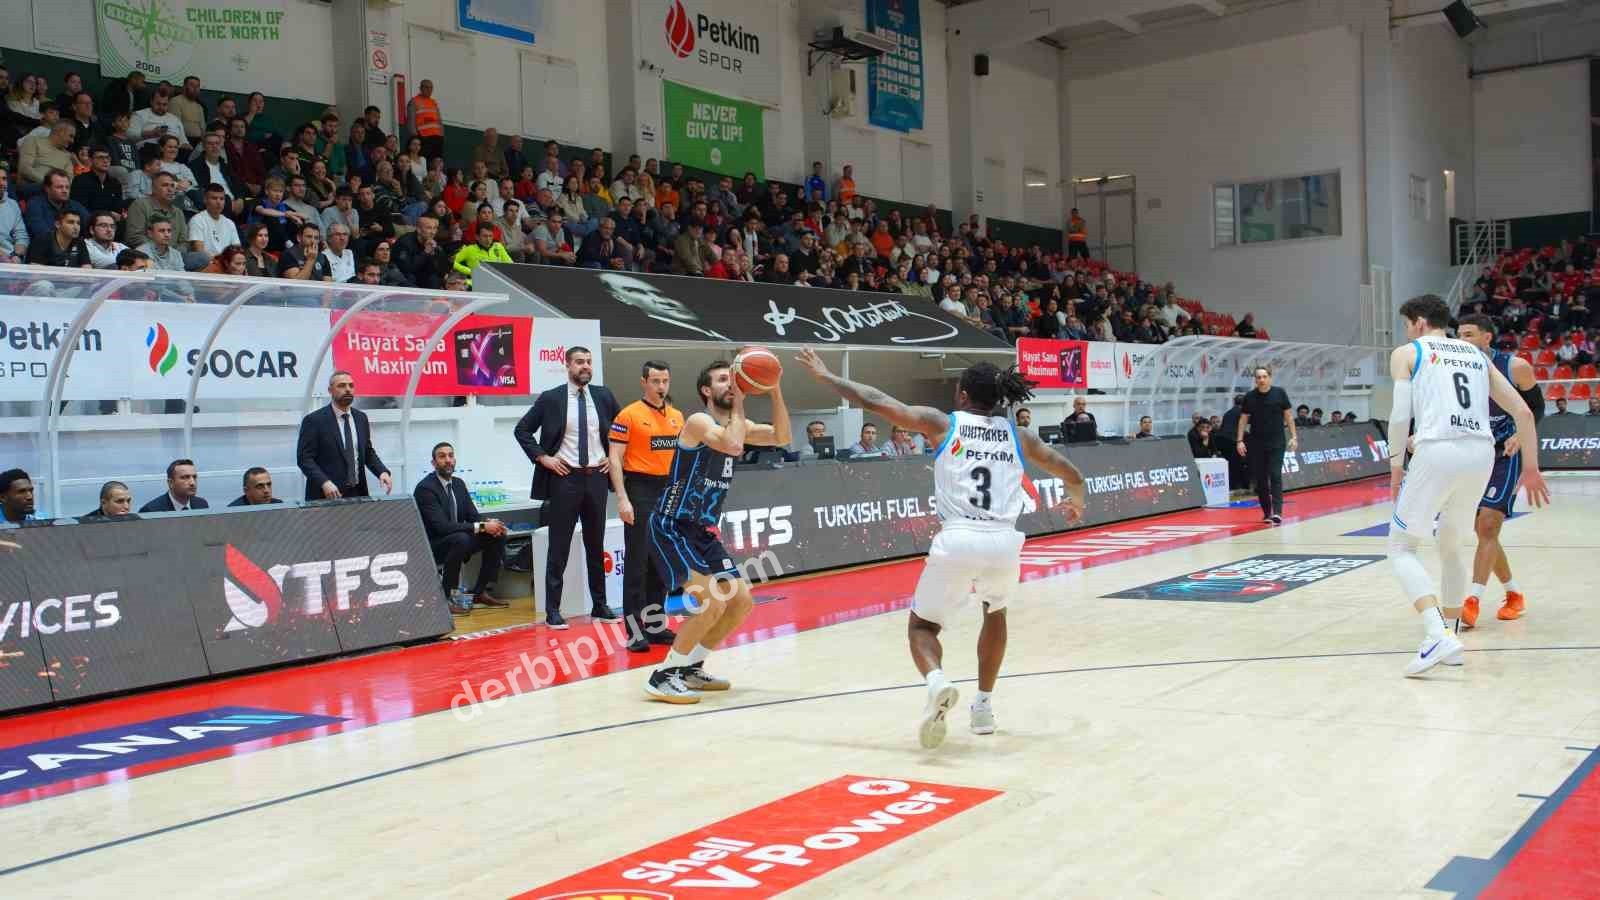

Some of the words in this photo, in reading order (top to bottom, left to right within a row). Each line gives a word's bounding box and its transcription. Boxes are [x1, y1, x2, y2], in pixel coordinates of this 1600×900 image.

[185, 8, 262, 25] CHILDREN
[266, 11, 285, 25] OF
[196, 24, 226, 39] THE
[231, 25, 280, 40] NORTH
[698, 13, 760, 55] Petkim
[698, 49, 742, 73] SPOR
[692, 103, 737, 123] NEVER
[686, 121, 718, 139] GIVE
[722, 124, 743, 142] UP!
[347, 332, 400, 356] Hayat
[404, 335, 446, 352] Saa
[187, 349, 299, 378] SOCAR
[499, 376, 516, 384] VISA
[1452, 372, 1471, 409] 6
[960, 425, 1009, 442] WHITTAKER
[721, 456, 733, 477] 8
[1085, 472, 1124, 494] TURKISH
[1125, 470, 1148, 488] FUEL
[1149, 465, 1190, 486] SERVICES
[969, 466, 991, 511] 3
[814, 501, 883, 528] TURKISH
[892, 496, 926, 520] FUEL
[289, 551, 410, 615] TFS
[672, 790, 955, 890] V-Power
[622, 837, 756, 885] Shell
